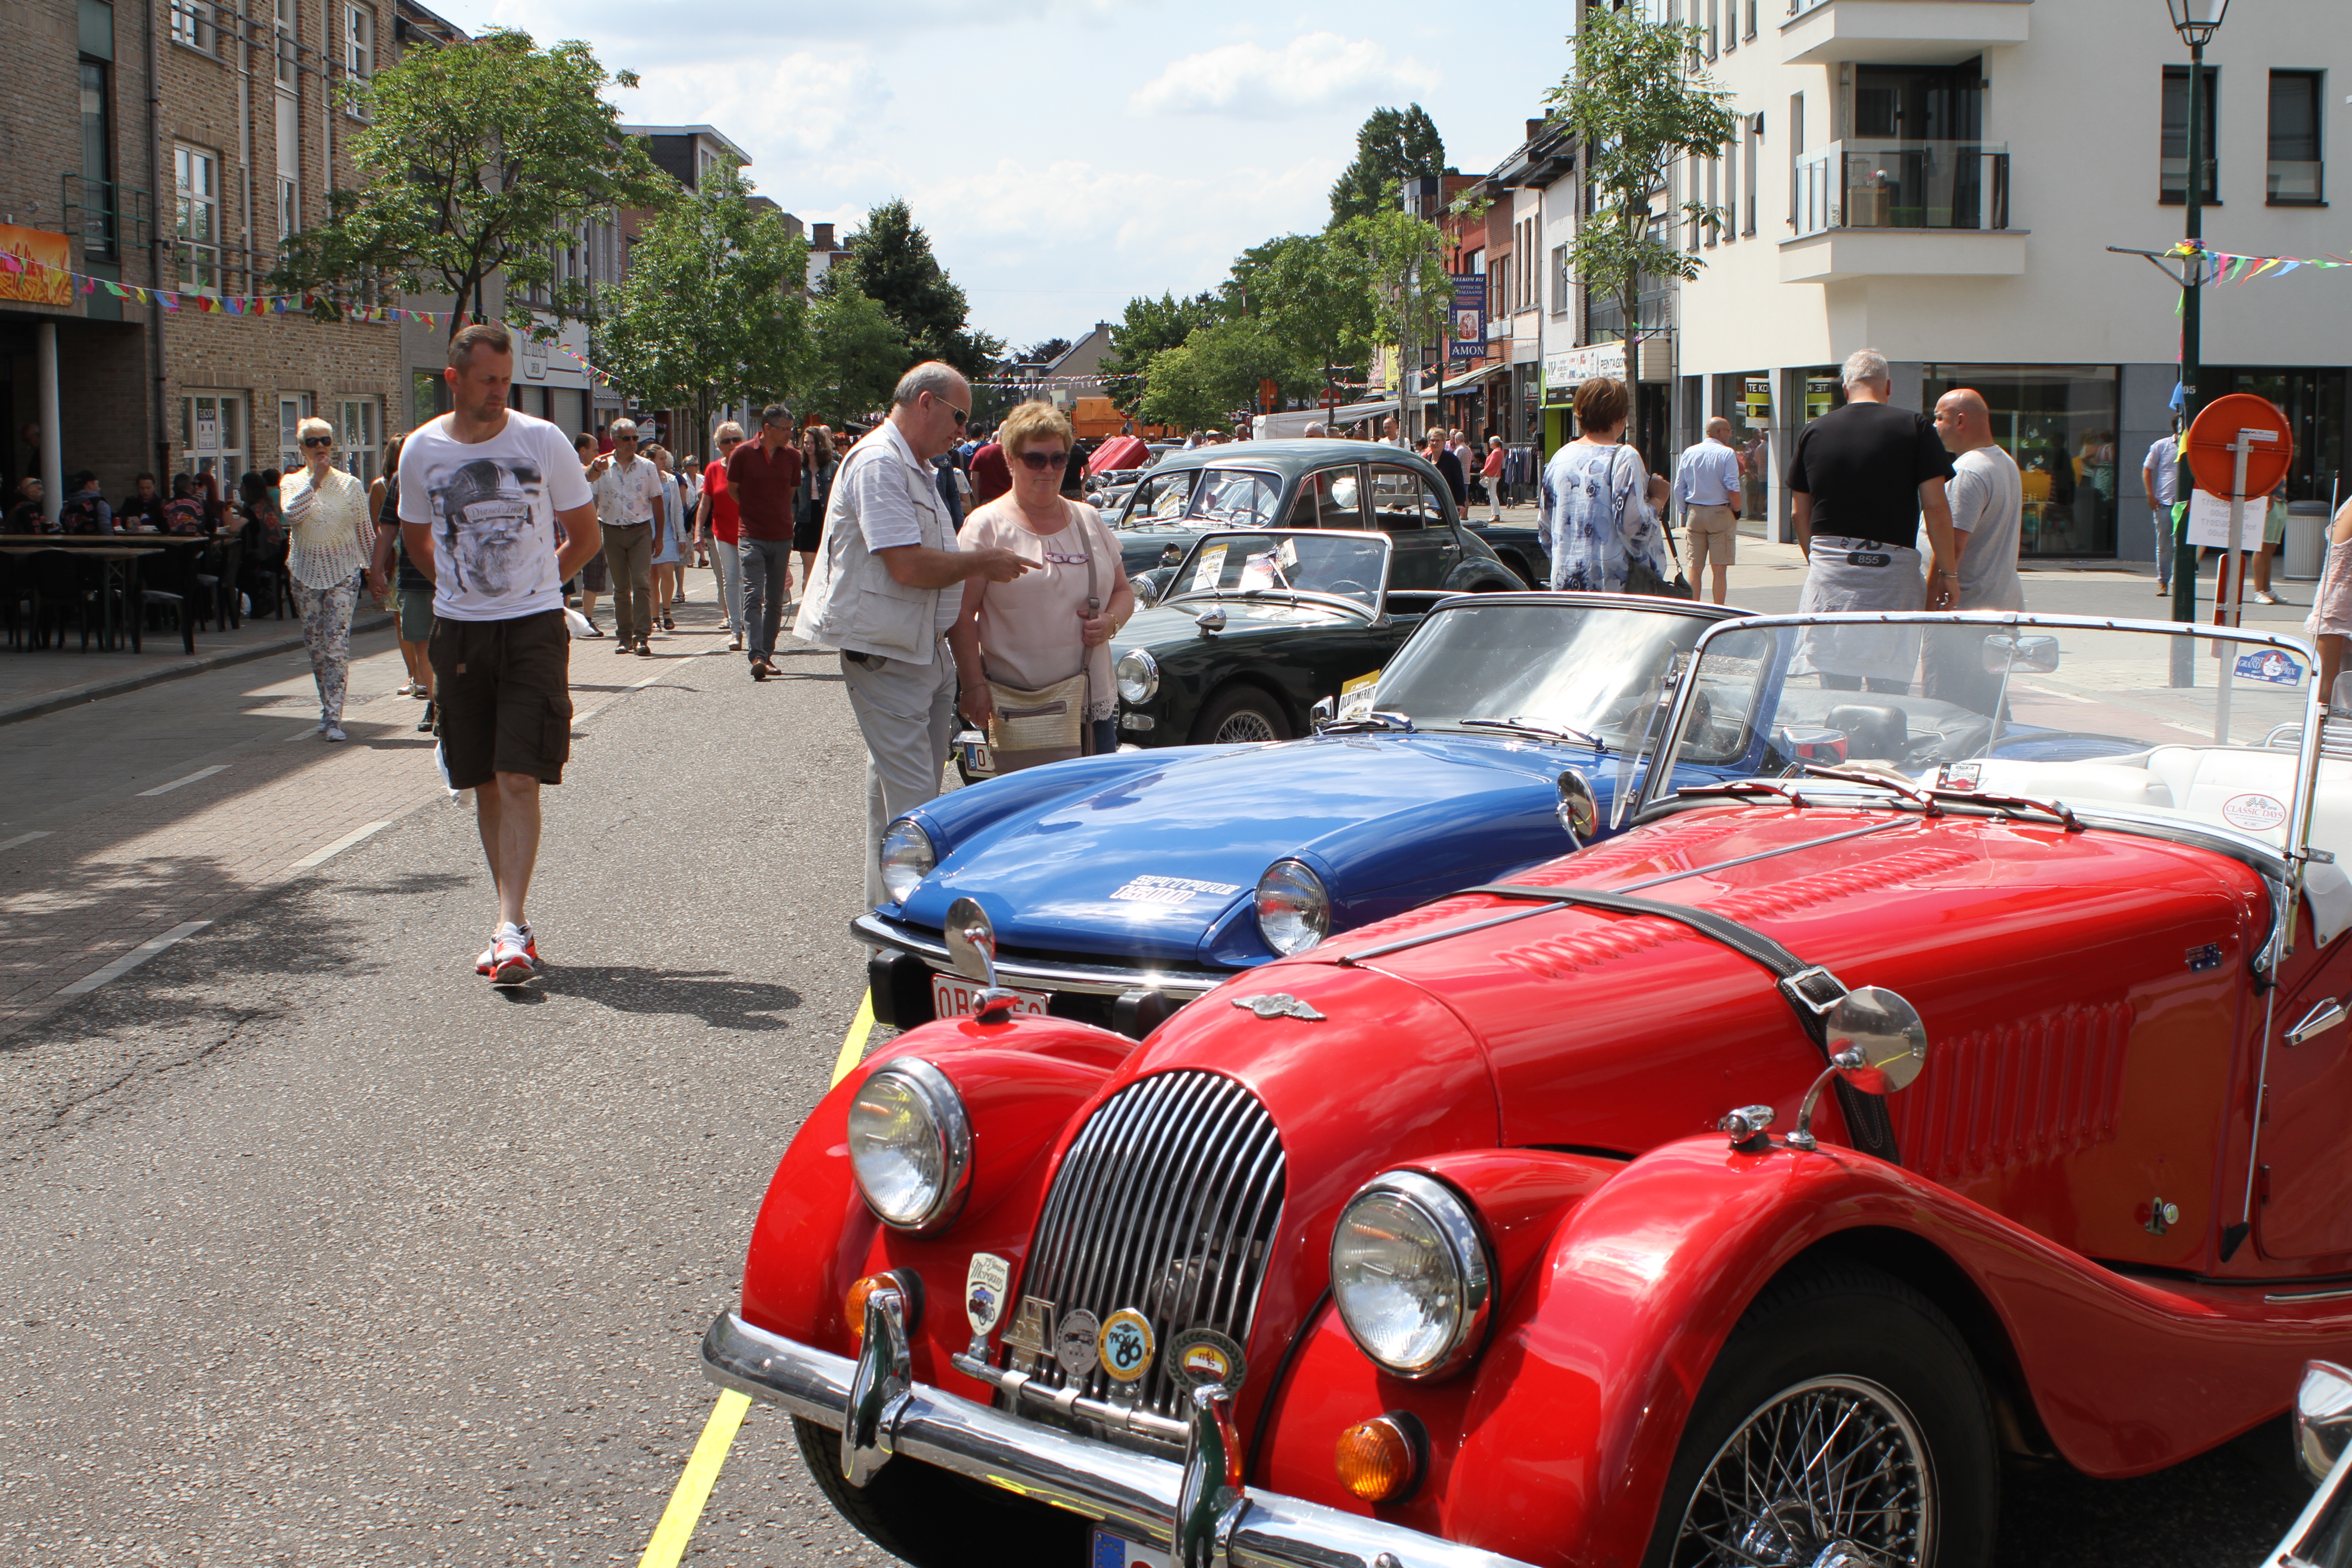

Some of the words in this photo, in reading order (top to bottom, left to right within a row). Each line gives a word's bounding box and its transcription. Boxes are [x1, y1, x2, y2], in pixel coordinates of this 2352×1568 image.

[1452, 346, 1484, 355] AMON
[471, 504, 503, 518] Diesel
[1858, 555, 1879, 564] 855
[2238, 660, 2261, 669] GRAND
[2282, 666, 2296, 675] PRIX
[2226, 805, 2261, 816] CLASSIC
[2262, 810, 2283, 818] DAYS
